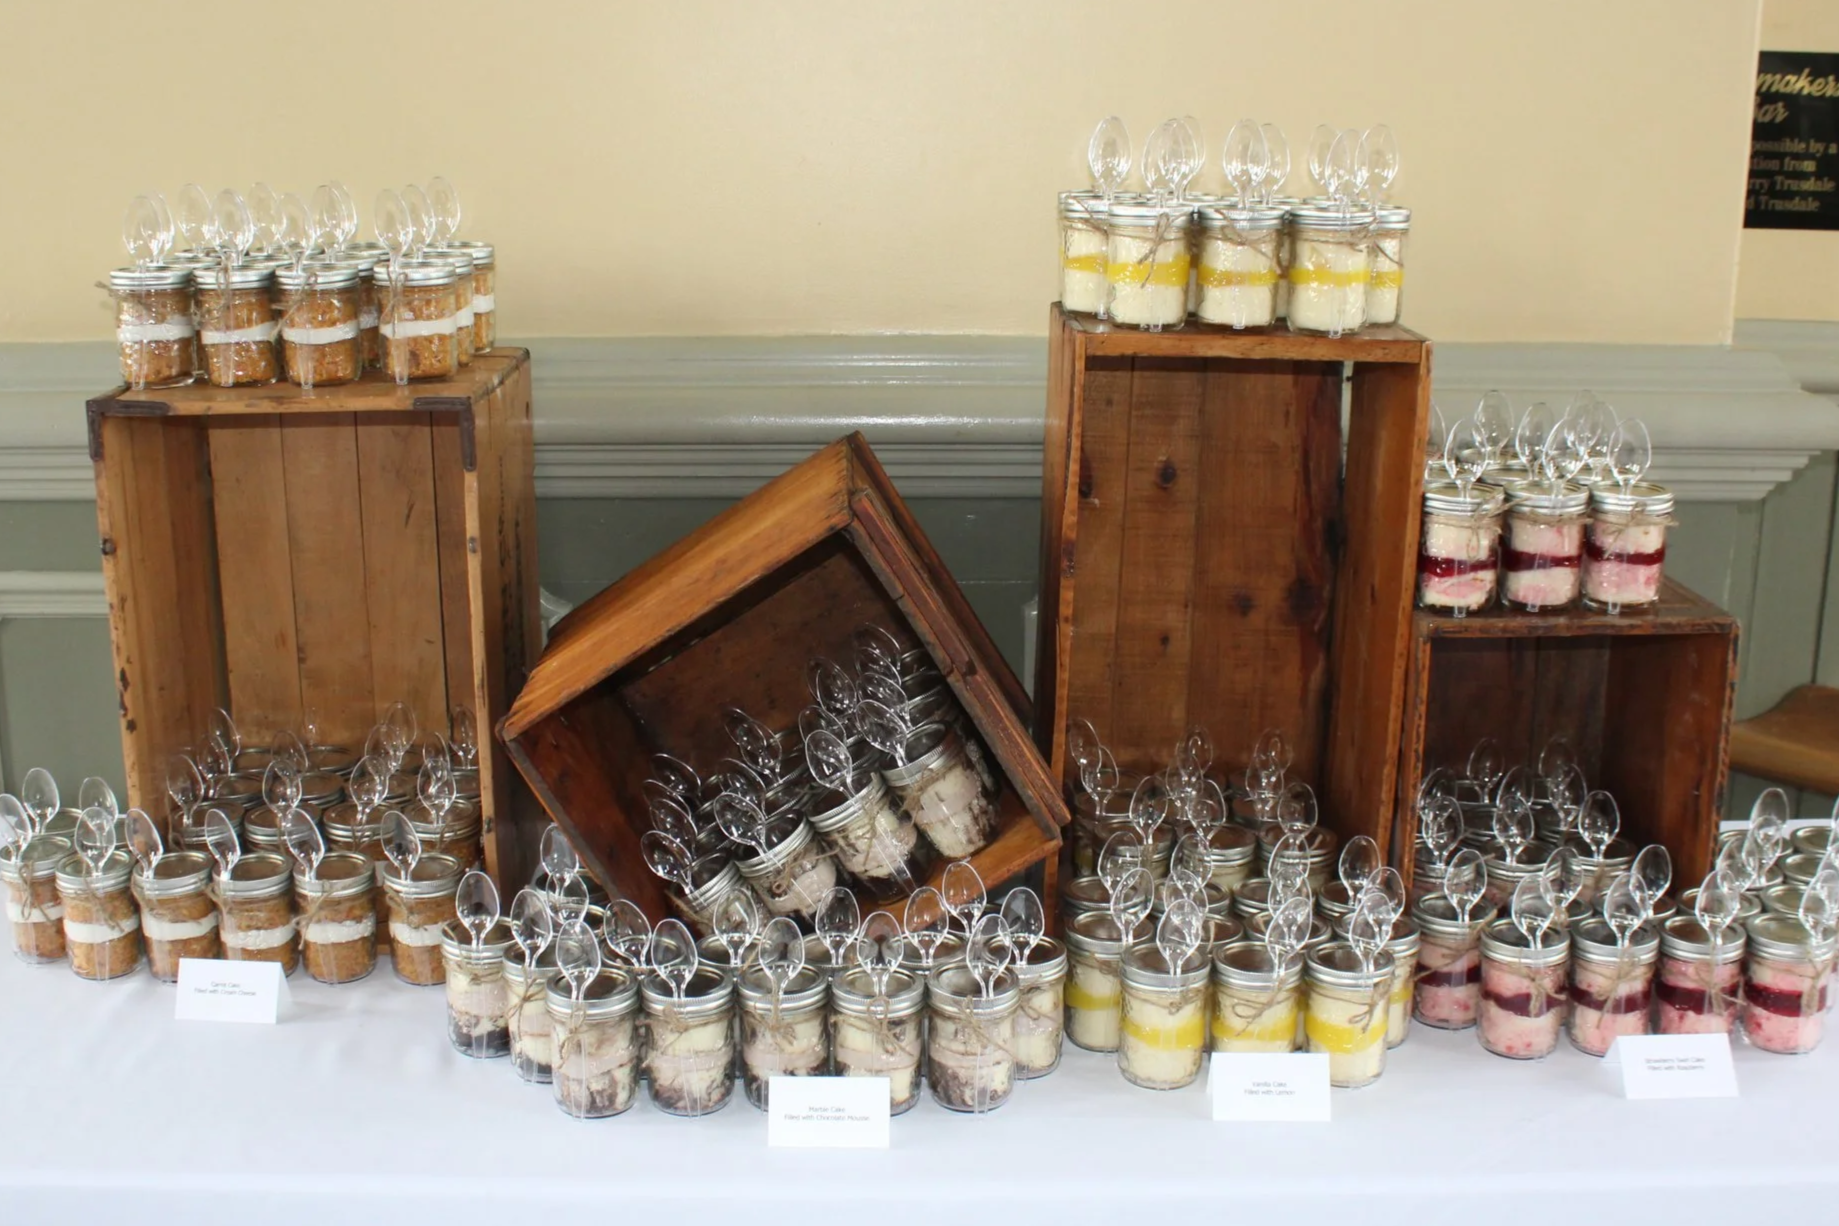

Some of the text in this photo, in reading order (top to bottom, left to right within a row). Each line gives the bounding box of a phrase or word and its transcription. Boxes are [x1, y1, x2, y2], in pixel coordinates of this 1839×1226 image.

[1808, 138, 1826, 157] by
[1828, 142, 1838, 154] a
[1750, 155, 1816, 171] tion from
[1748, 178, 1770, 193] rry
